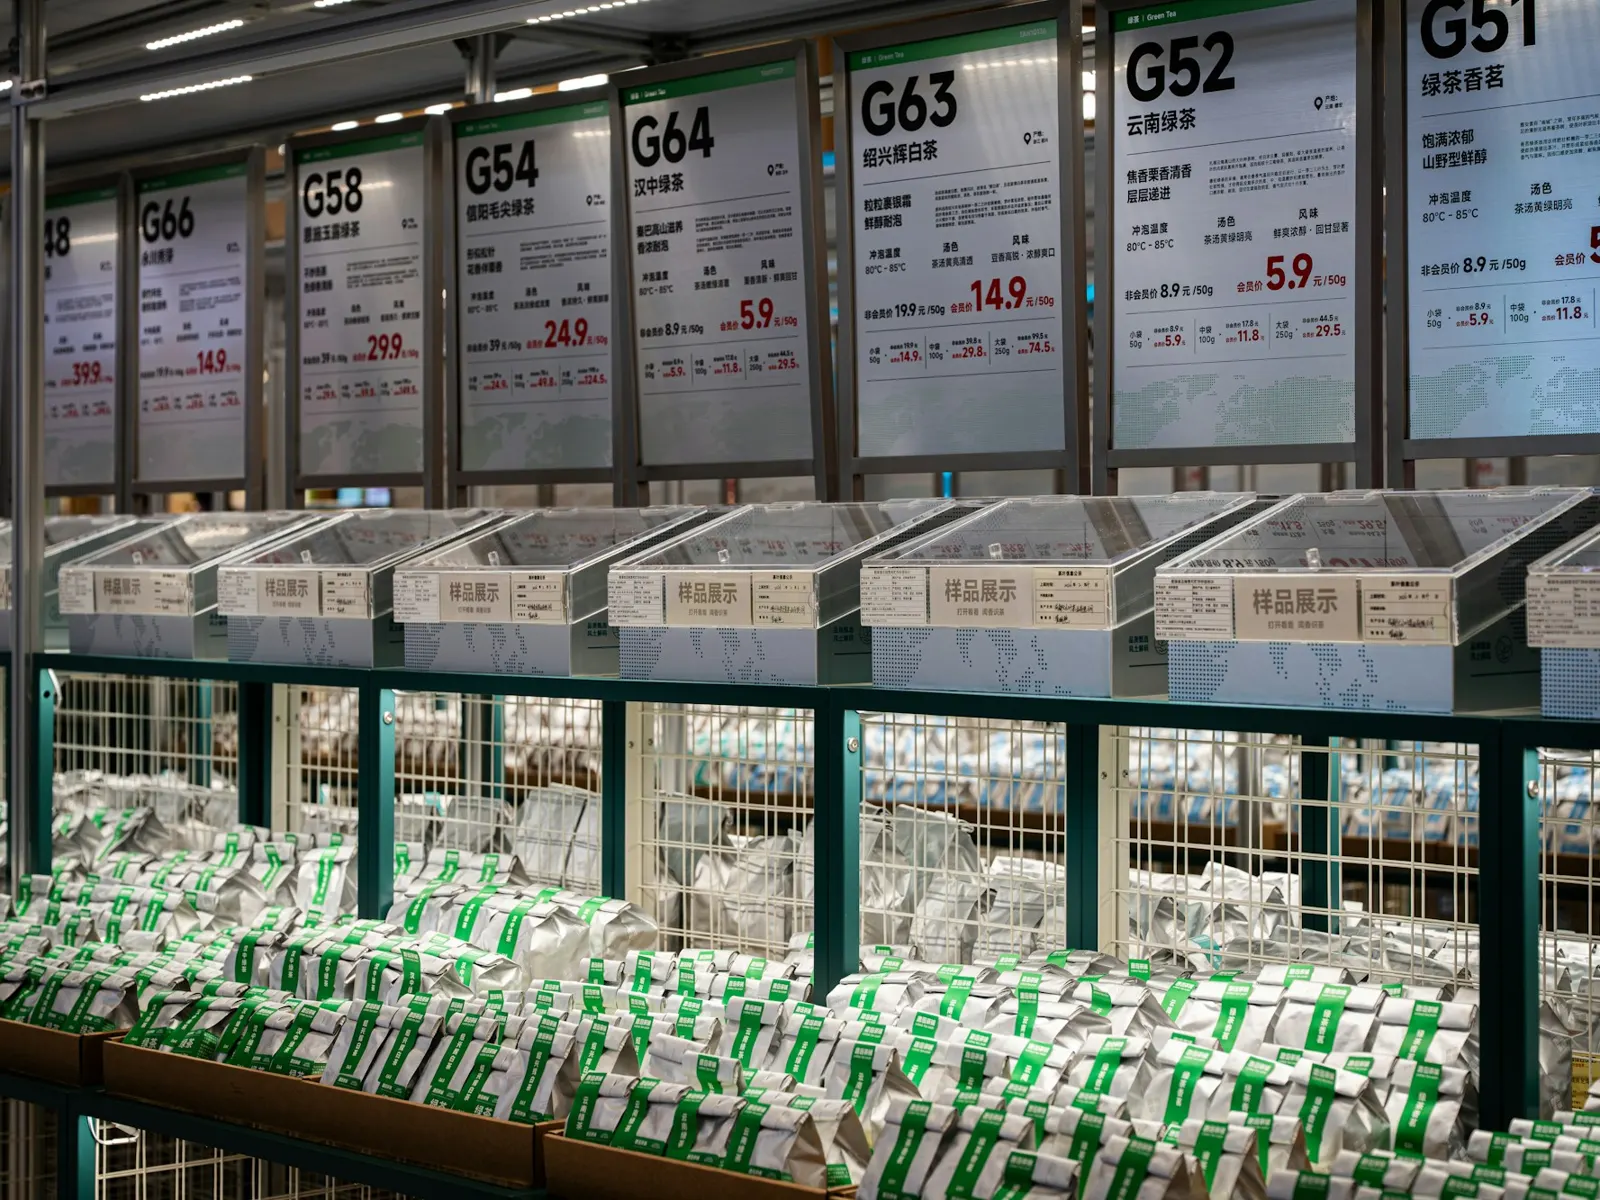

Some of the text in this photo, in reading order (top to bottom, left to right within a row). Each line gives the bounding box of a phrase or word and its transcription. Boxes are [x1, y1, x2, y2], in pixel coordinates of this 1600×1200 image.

[1147, 13, 1165, 22] Green
[1166, 10, 1177, 18] Tea
[1421, 0, 1536, 59] G51
[1126, 30, 1236, 102] G52
[1421, 64, 1505, 97] 绿茶香茗
[861, 69, 958, 137] G63
[1126, 107, 1196, 137] 云南绿茶
[632, 106, 714, 168] G64
[1422, 129, 1474, 149] 饱满浓郁
[863, 140, 938, 169] 绍兴辉白茶
[1422, 149, 1487, 170] 山野型鲜醇
[466, 139, 539, 195] G54
[1126, 163, 1192, 185] 焦香栗香清香
[303, 167, 363, 219] G58
[634, 172, 684, 197] 汉中绿茶
[1530, 182, 1552, 195] 汤色
[864, 194, 912, 213] 粒粒裹银霜
[1126, 186, 1171, 204] 层层递进
[1429, 190, 1472, 205] 冲泡温度
[467, 197, 535, 223] 信阳毛尖绿茶
[1298, 207, 1319, 221] 风味
[1514, 198, 1573, 215] 茶汤黄绿明亮
[142, 195, 195, 243] G66
[864, 213, 903, 231] 鲜醇耐泡
[1217, 216, 1236, 228] 汤色
[1132, 222, 1168, 237] 冲泡温度
[943, 241, 959, 253] 汤色
[1012, 234, 1030, 246] 风味
[1203, 231, 1253, 246] 茶汤黄绿明亮
[869, 247, 901, 260] 冲泡温度
[1554, 252, 1586, 266] 会员价
[1236, 280, 1263, 293] 会员价
[1266, 252, 1313, 291] 5.9
[1421, 256, 1526, 277] 非会员价 8.9 元 /50g
[950, 302, 973, 314] 会员价
[970, 275, 1027, 312] 14.9
[1125, 283, 1213, 301] 非会员价 8.9 元 /50g
[1561, 296, 1576, 305] 17.8
[740, 297, 774, 330] 5.9
[864, 309, 893, 320] 非会员价
[894, 303, 917, 318] 19.9
[1427, 309, 1442, 318] 小袋
[1474, 302, 1486, 311] 8.9
[1510, 303, 1525, 312] 中袋
[1556, 306, 1582, 321] 11.8
[1427, 319, 1442, 329] 50g
[1469, 312, 1489, 326] 5.9
[1510, 314, 1529, 323] 100g
[544, 317, 588, 348] 24.9
[665, 322, 680, 336] 8.9
[1237, 328, 1260, 342] 11.8
[1275, 330, 1293, 340] 250g
[1315, 323, 1341, 338] 29.5
[367, 332, 402, 361] 29.9
[1029, 342, 1050, 354] 74.5
[1129, 340, 1142, 350] 50g
[1165, 334, 1182, 347] 5.9
[1199, 335, 1215, 345] 100g
[900, 351, 919, 363] 14.9
[929, 352, 943, 360] 100g
[962, 346, 983, 359] 29.8
[196, 348, 227, 375] 14.9
[103, 577, 141, 597] 样品展示
[265, 577, 309, 599] 样品展示
[450, 582, 499, 603] 样品展示
[678, 582, 738, 605] 样品展示
[945, 579, 1017, 604] 样品展示
[1252, 588, 1338, 615] 样品展示
